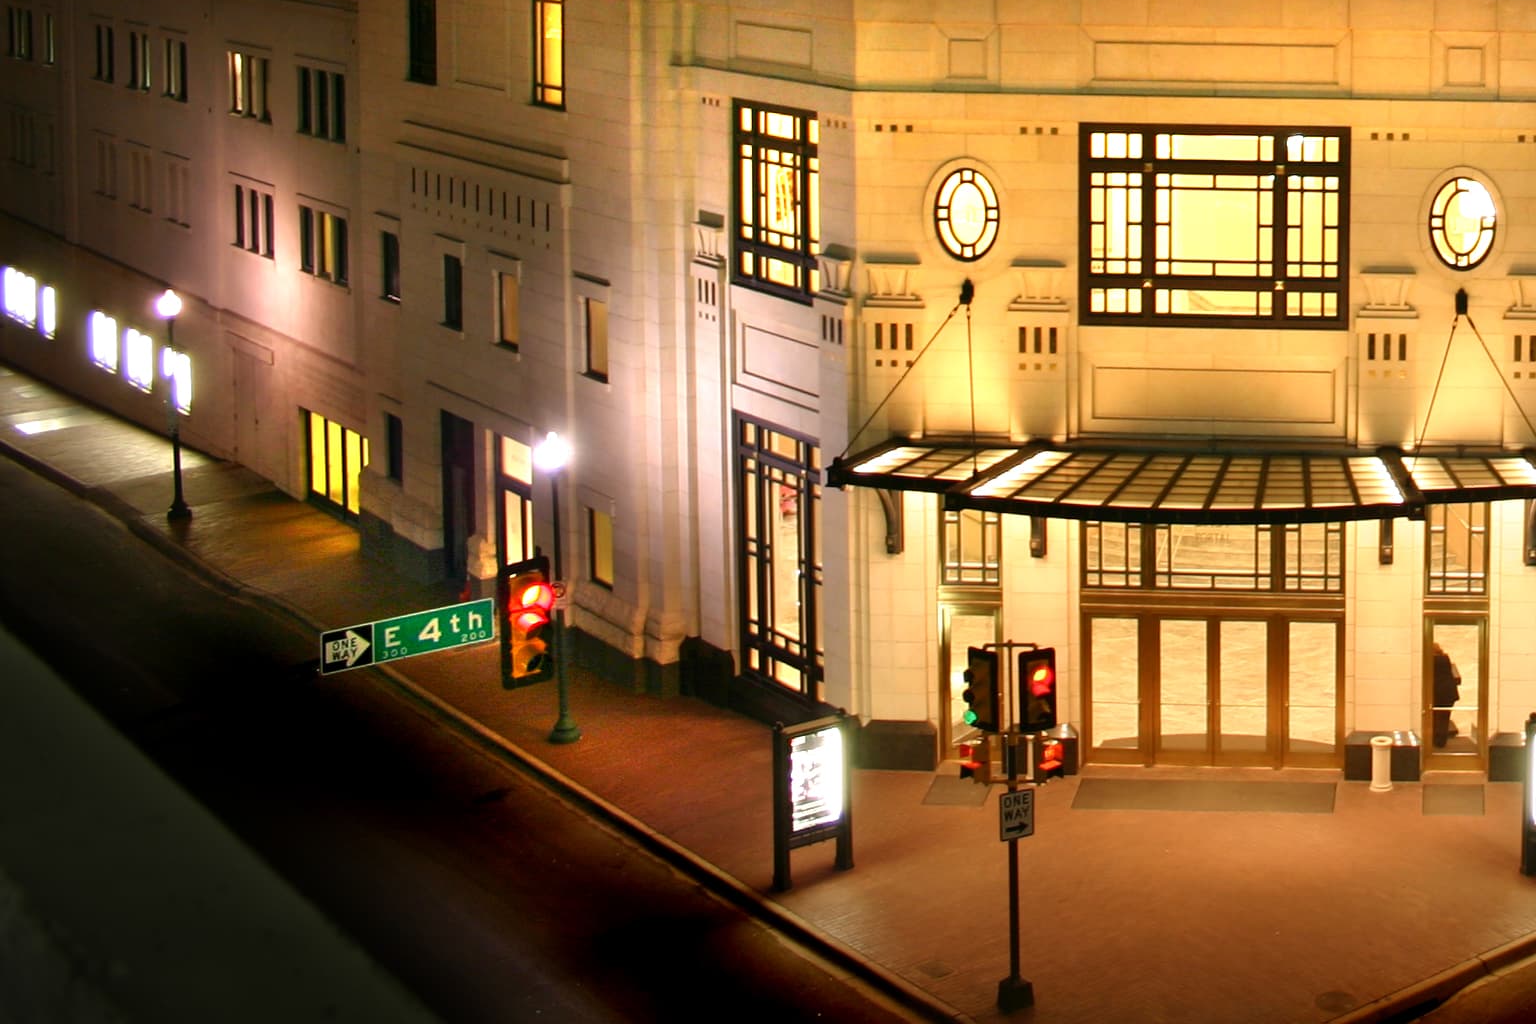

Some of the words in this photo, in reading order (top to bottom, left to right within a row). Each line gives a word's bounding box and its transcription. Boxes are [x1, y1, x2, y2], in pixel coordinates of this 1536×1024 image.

[384, 626, 401, 648] E
[418, 610, 483, 643] 4th
[461, 630, 486, 643] 200
[332, 637, 357, 651] ONE
[332, 648, 357, 661] WAY
[382, 647, 408, 659] 300
[1004, 793, 1030, 808] ONE
[1004, 806, 1030, 822] WAY
